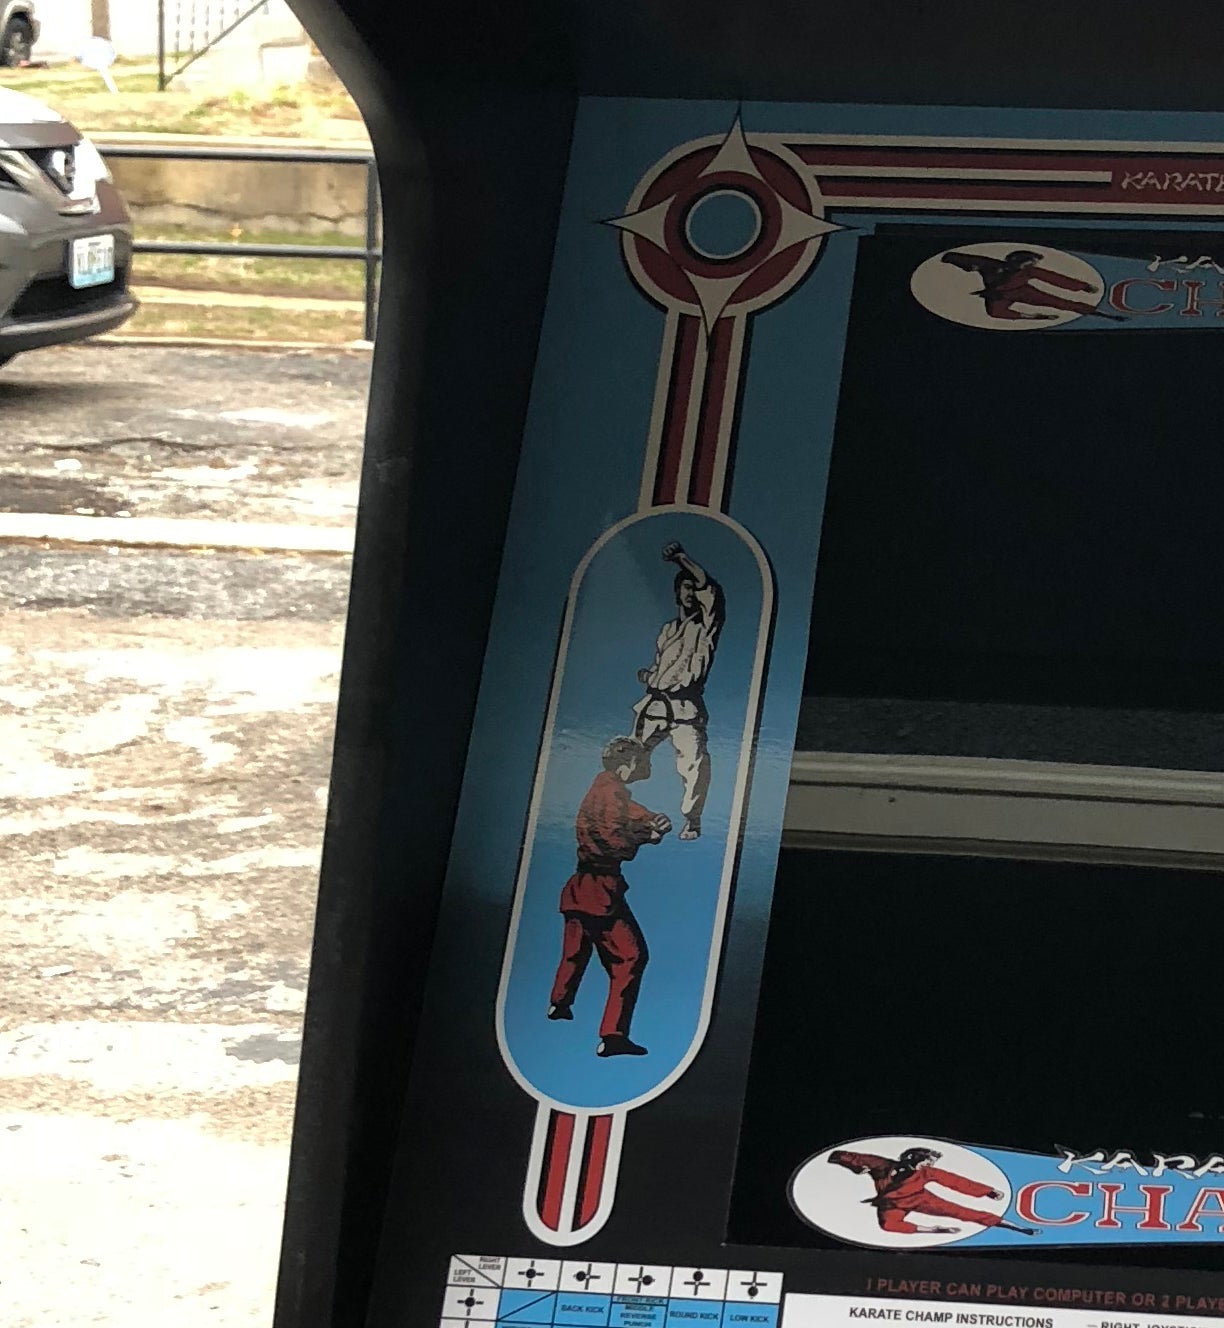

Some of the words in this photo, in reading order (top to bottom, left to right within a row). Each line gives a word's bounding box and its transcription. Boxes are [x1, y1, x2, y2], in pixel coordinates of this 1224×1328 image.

[877, 1279, 941, 1295] PLAYER
[946, 1283, 981, 1297] CAN
[986, 1283, 1029, 1299] PLAY
[1033, 1286, 1126, 1307] COMPUTER
[1132, 1293, 1155, 1307] OR
[1161, 1295, 1169, 1309] 2
[750, 1315, 768, 1323] KICK
[849, 1307, 902, 1321] KARATE
[905, 1310, 953, 1324] CHAMP
[956, 1313, 1053, 1328] INSTRUCTIONS
